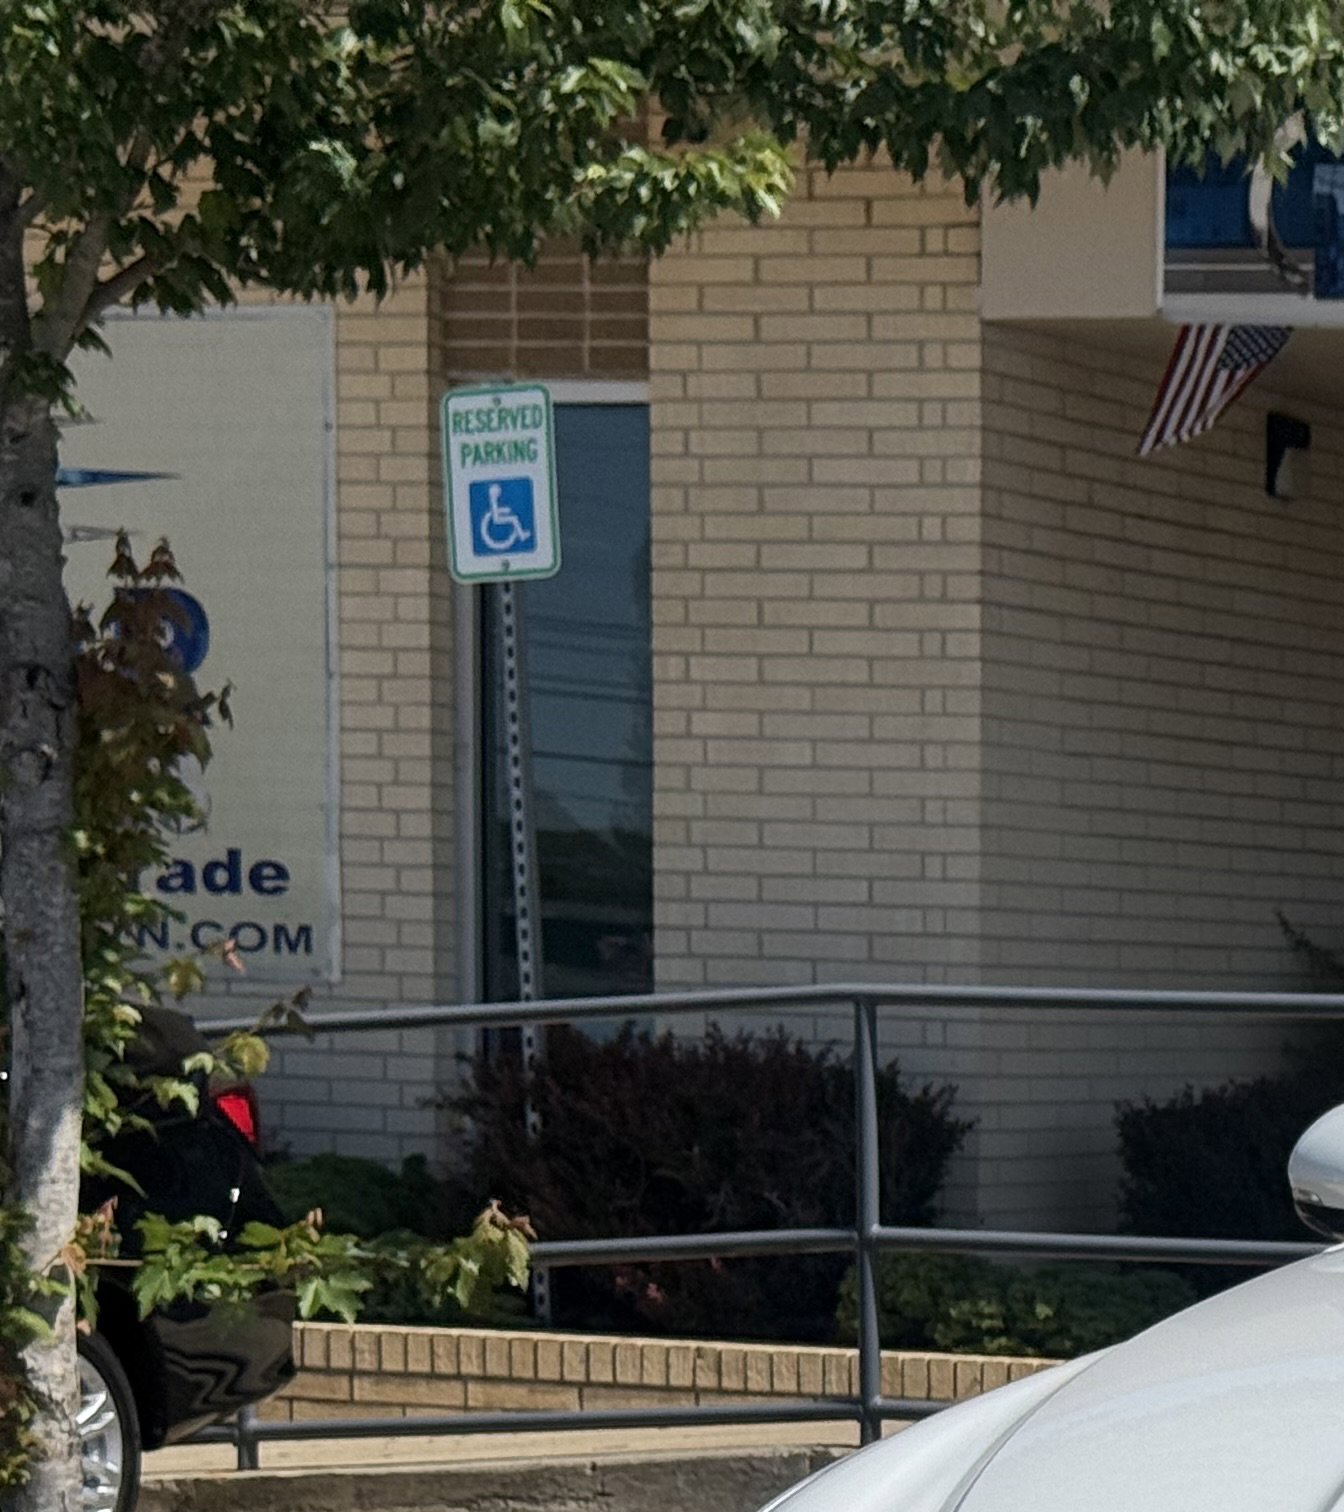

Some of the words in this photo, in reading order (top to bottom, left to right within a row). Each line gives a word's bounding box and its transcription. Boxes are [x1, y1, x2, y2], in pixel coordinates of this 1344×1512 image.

[452, 403, 543, 434] RESERVED
[460, 437, 538, 469] PARKING
[157, 847, 292, 896] ade
